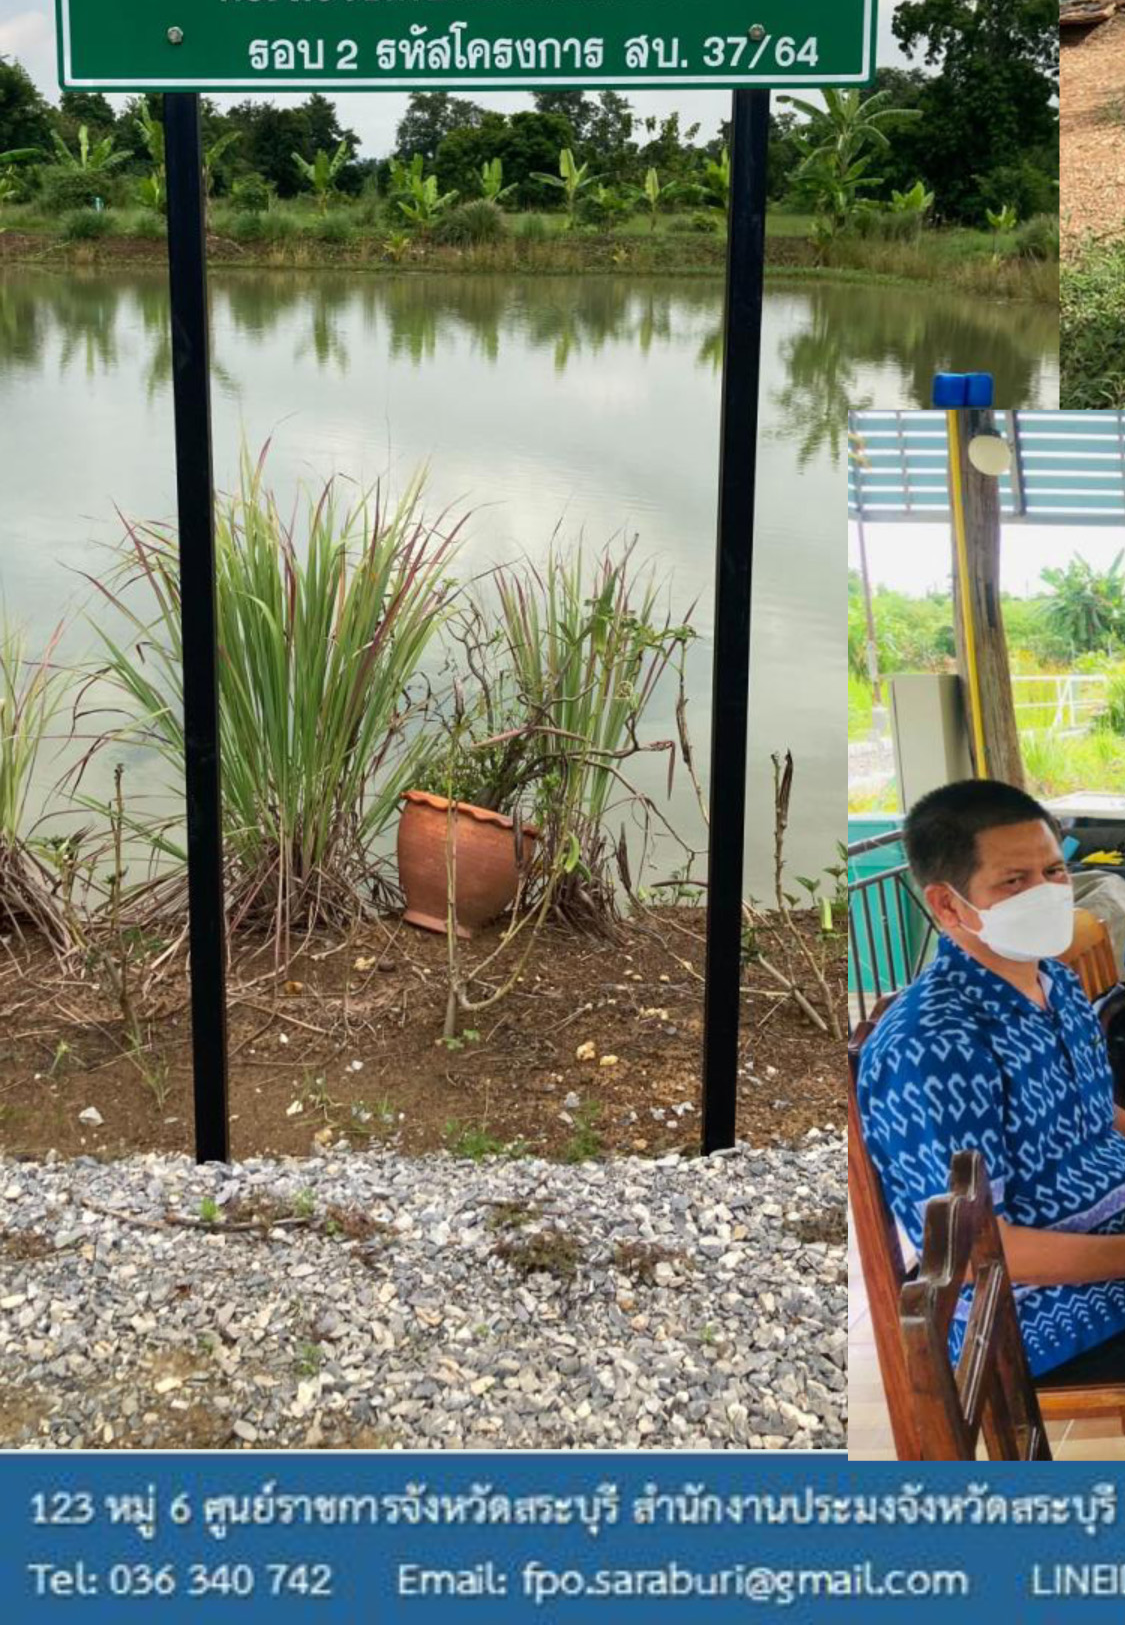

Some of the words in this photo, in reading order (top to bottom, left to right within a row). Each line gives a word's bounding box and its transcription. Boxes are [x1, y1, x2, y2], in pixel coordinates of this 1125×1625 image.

[249, 39, 325, 71] รอบ
[336, 39, 358, 70] 2
[376, 21, 604, 71] รหัสโครงการ
[624, 35, 688, 69] สบ.
[703, 35, 819, 69] 37/64
